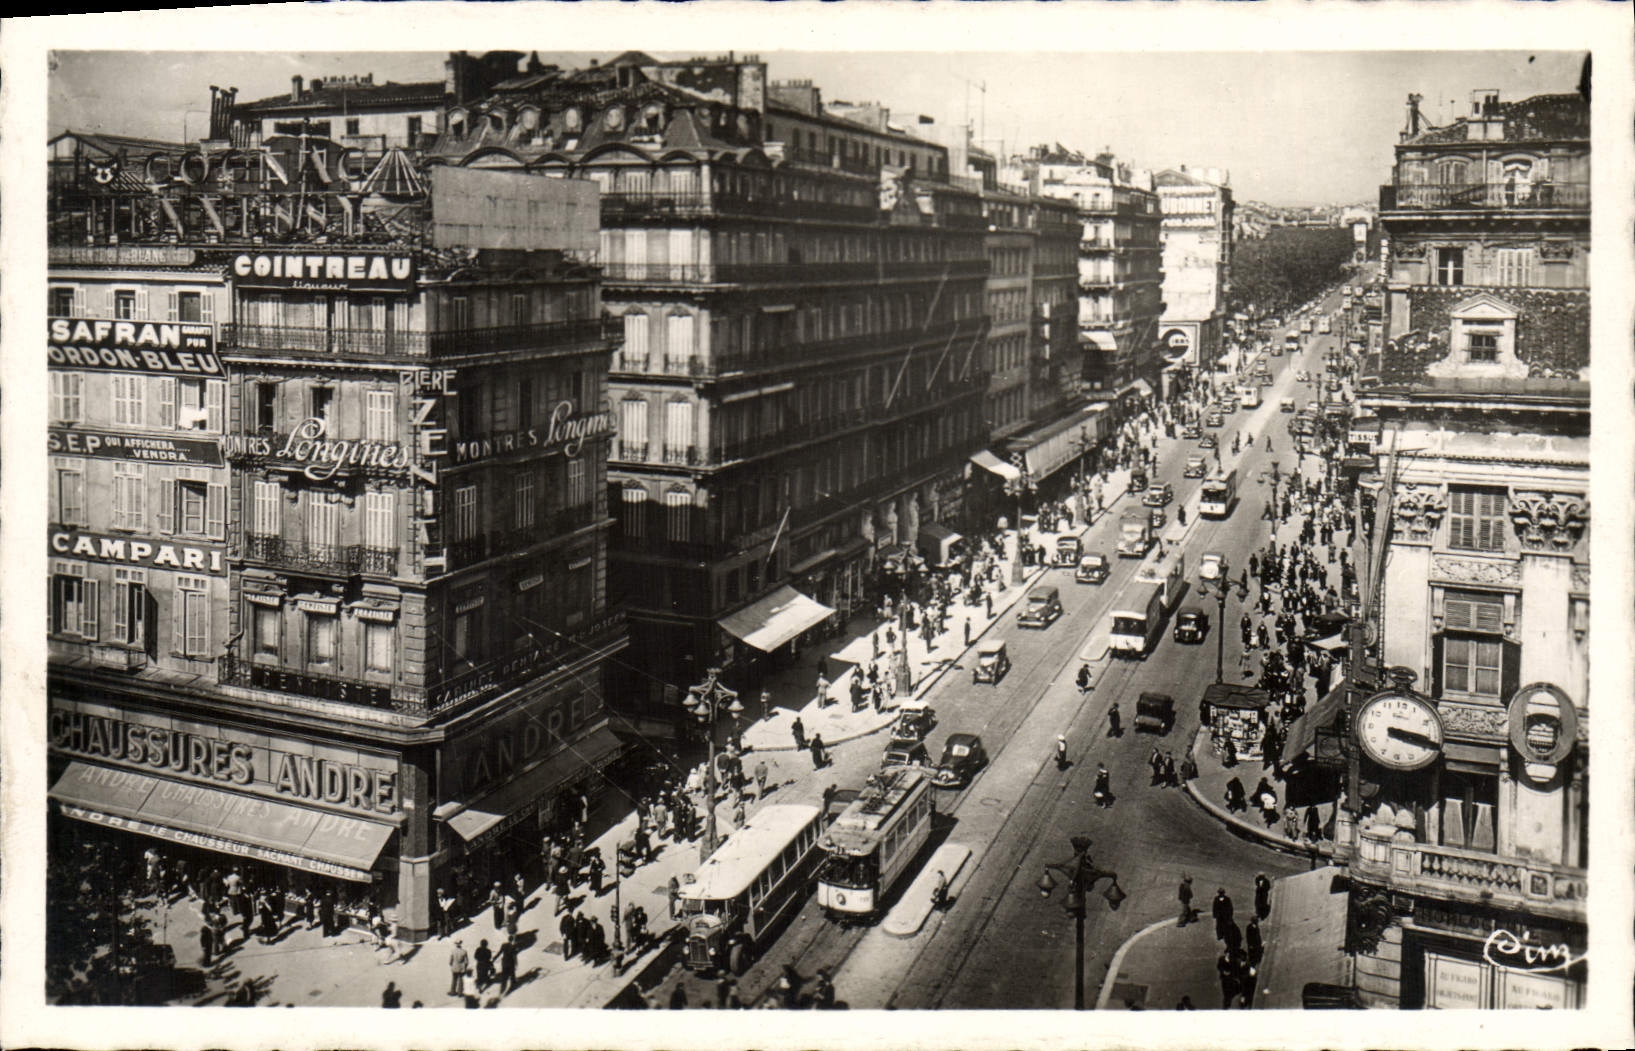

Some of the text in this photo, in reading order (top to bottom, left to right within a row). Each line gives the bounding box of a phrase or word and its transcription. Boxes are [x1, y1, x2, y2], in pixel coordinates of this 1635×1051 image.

[234, 255, 411, 280] COINTREAU
[51, 320, 181, 348] SAFRAN
[105, 436, 122, 447] QUI
[219, 416, 410, 480] MONTRES Longines
[456, 428, 537, 463] MONTRES
[52, 533, 222, 572] CAMPARI
[473, 697, 585, 786] ANDRE
[48, 709, 398, 815] CHAUSSURES ANDRE
[78, 764, 153, 796] ANDRE
[278, 810, 372, 843] ANDRE
[150, 825, 168, 836] LE
[174, 830, 250, 856] CHAUSSEUR
